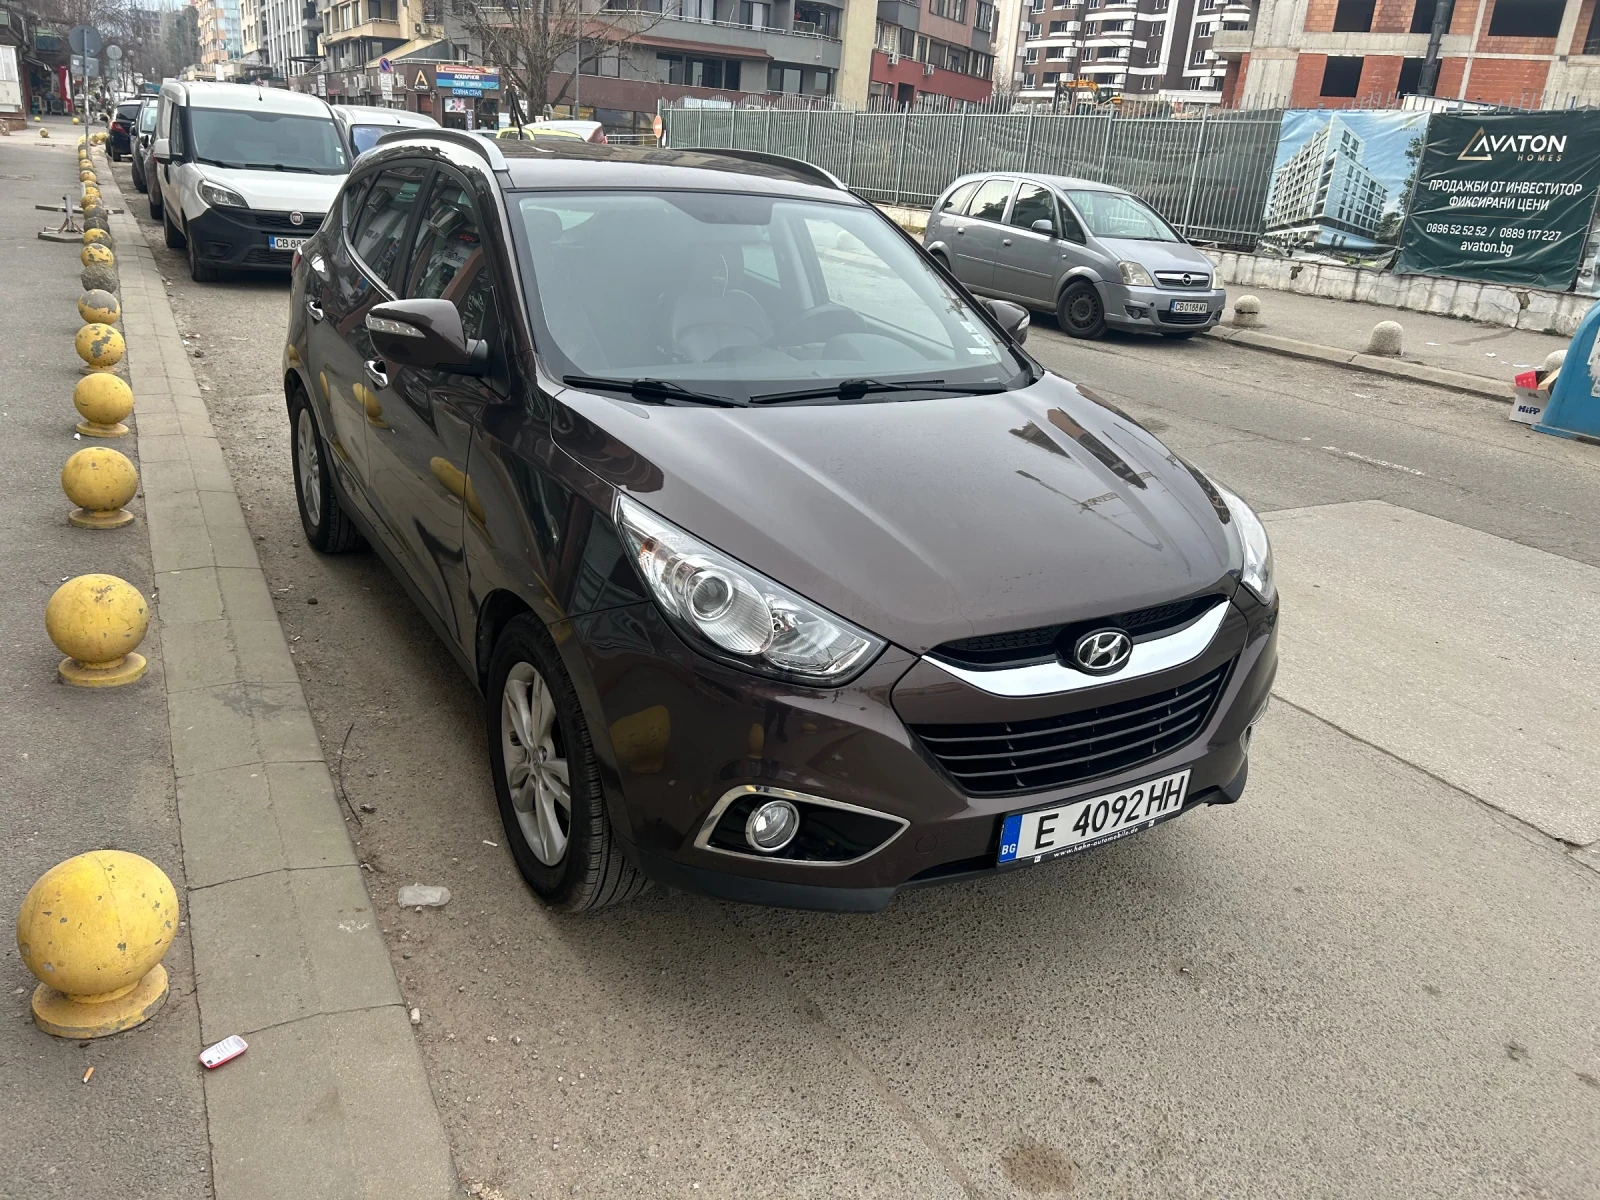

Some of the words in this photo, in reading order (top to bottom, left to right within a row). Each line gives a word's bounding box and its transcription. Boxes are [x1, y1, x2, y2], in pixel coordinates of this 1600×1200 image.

[1473, 134, 1567, 153] AVATON
[1517, 154, 1563, 162] HOMES
[1428, 180, 1489, 194] ПРОДАЖБИ
[1490, 182, 1505, 193] ОТ
[1505, 182, 1583, 196] ИНВЕСТИТОР
[1449, 196, 1516, 210] ФИКСИРАНИ
[1517, 198, 1550, 213] ЦЕНИ
[1426, 223, 1449, 234] 0896
[1449, 225, 1461, 235] 52
[1462, 226, 1474, 236] 52
[1475, 226, 1487, 237] 52
[1499, 228, 1525, 239] 0889
[1527, 229, 1541, 240] 117
[1543, 230, 1561, 242] 227
[276, 239, 288, 248] CB
[1460, 241, 1513, 257] avaton.bg
[1517, 405, 1541, 415] HiPP
[1034, 813, 1059, 850] E
[1001, 844, 1016, 855] BG
